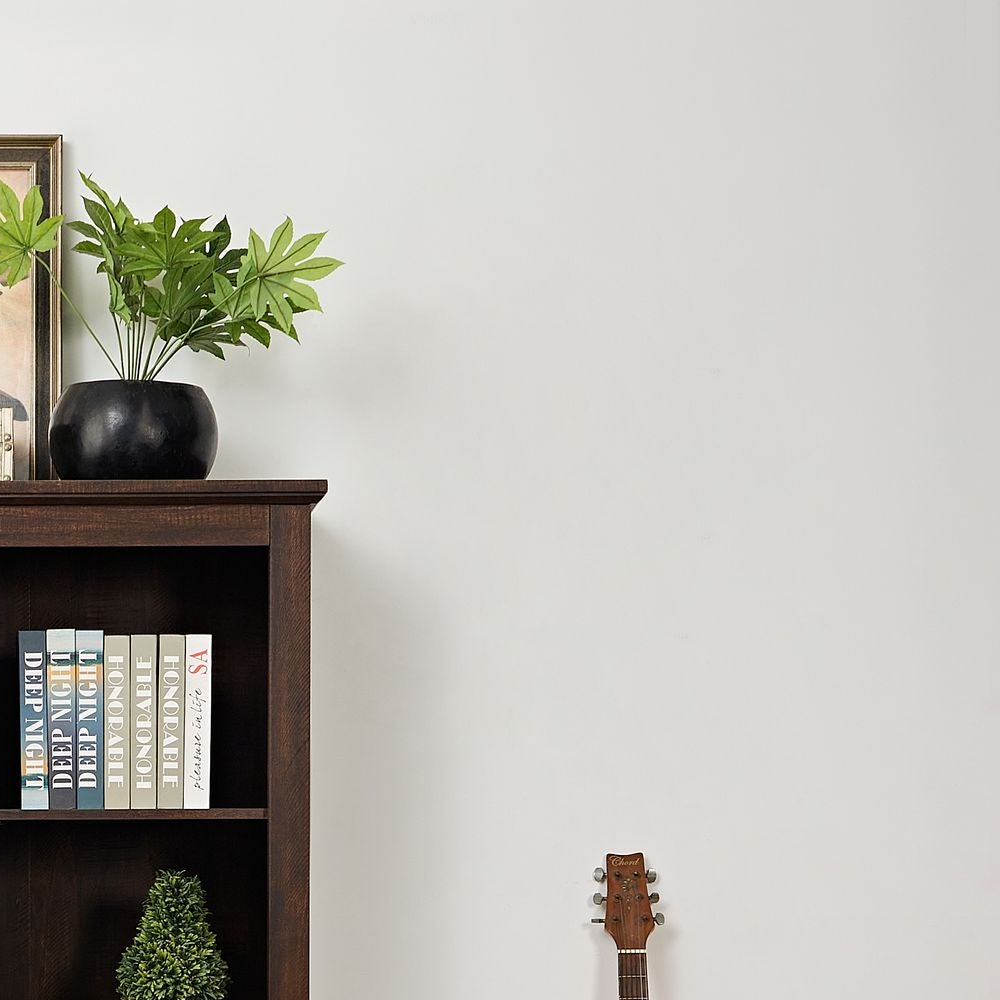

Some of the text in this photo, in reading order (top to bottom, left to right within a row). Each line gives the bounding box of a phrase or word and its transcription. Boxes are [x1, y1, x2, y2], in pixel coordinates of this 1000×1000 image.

[24, 651, 45, 791] DEEP NIGHT
[50, 649, 73, 790] DEEP NIGHT
[78, 649, 97, 789] DEEP NIGHT
[107, 655, 125, 788] HONORABLE
[135, 656, 153, 789] HONORABLE
[162, 655, 180, 788] HONORABLE
[188, 649, 208, 675] SA
[189, 688, 206, 790] pleasure in life
[610, 856, 640, 866] Chord
